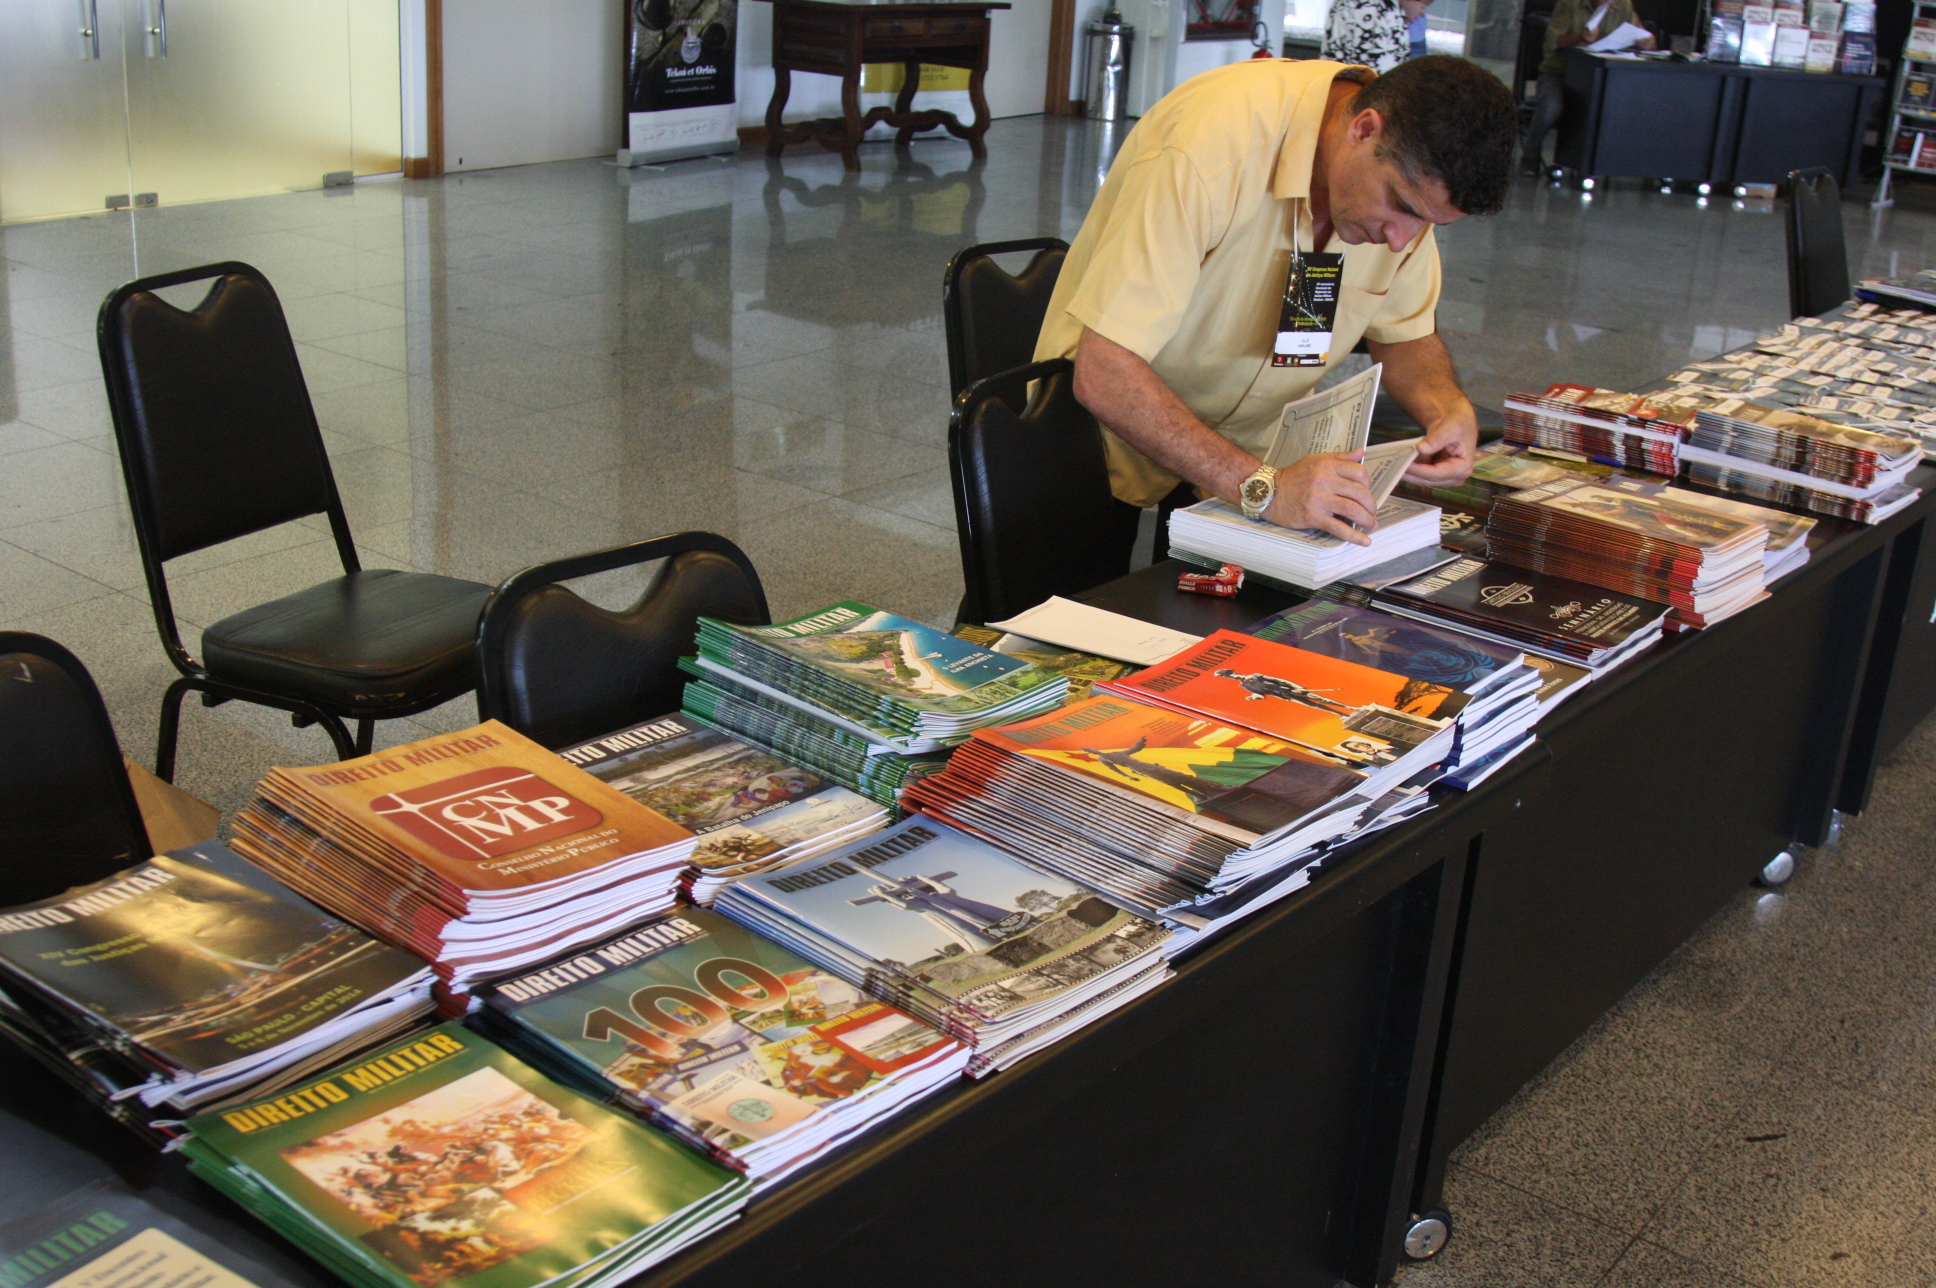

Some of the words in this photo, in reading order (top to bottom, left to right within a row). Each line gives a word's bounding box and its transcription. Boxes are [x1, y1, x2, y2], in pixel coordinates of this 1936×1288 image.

[786, 607, 862, 635] MILITAR
[1138, 664, 1202, 693] DIREITO
[1190, 638, 1247, 671] MILITAR
[599, 718, 689, 753] MILITAR
[1001, 723, 1073, 744] DIREITO
[1060, 702, 1130, 731] MILITAR
[304, 758, 405, 787] DIREITO
[404, 732, 502, 768] MILITAR
[705, 817, 741, 833] Batalha
[740, 812, 753, 822] do
[753, 799, 791, 817] Jenipapo
[765, 860, 858, 894] DIREITO
[847, 825, 940, 869] MILITAR
[63, 866, 177, 917] MILITAR
[496, 957, 606, 1002] DIREITO
[596, 916, 702, 967] MILITAR
[252, 1013, 297, 1034] PAULO
[301, 984, 353, 1012] CAPITAL
[582, 956, 790, 1059] 100
[221, 1081, 351, 1134] DIREITO
[340, 1033, 465, 1093] MILITAR
